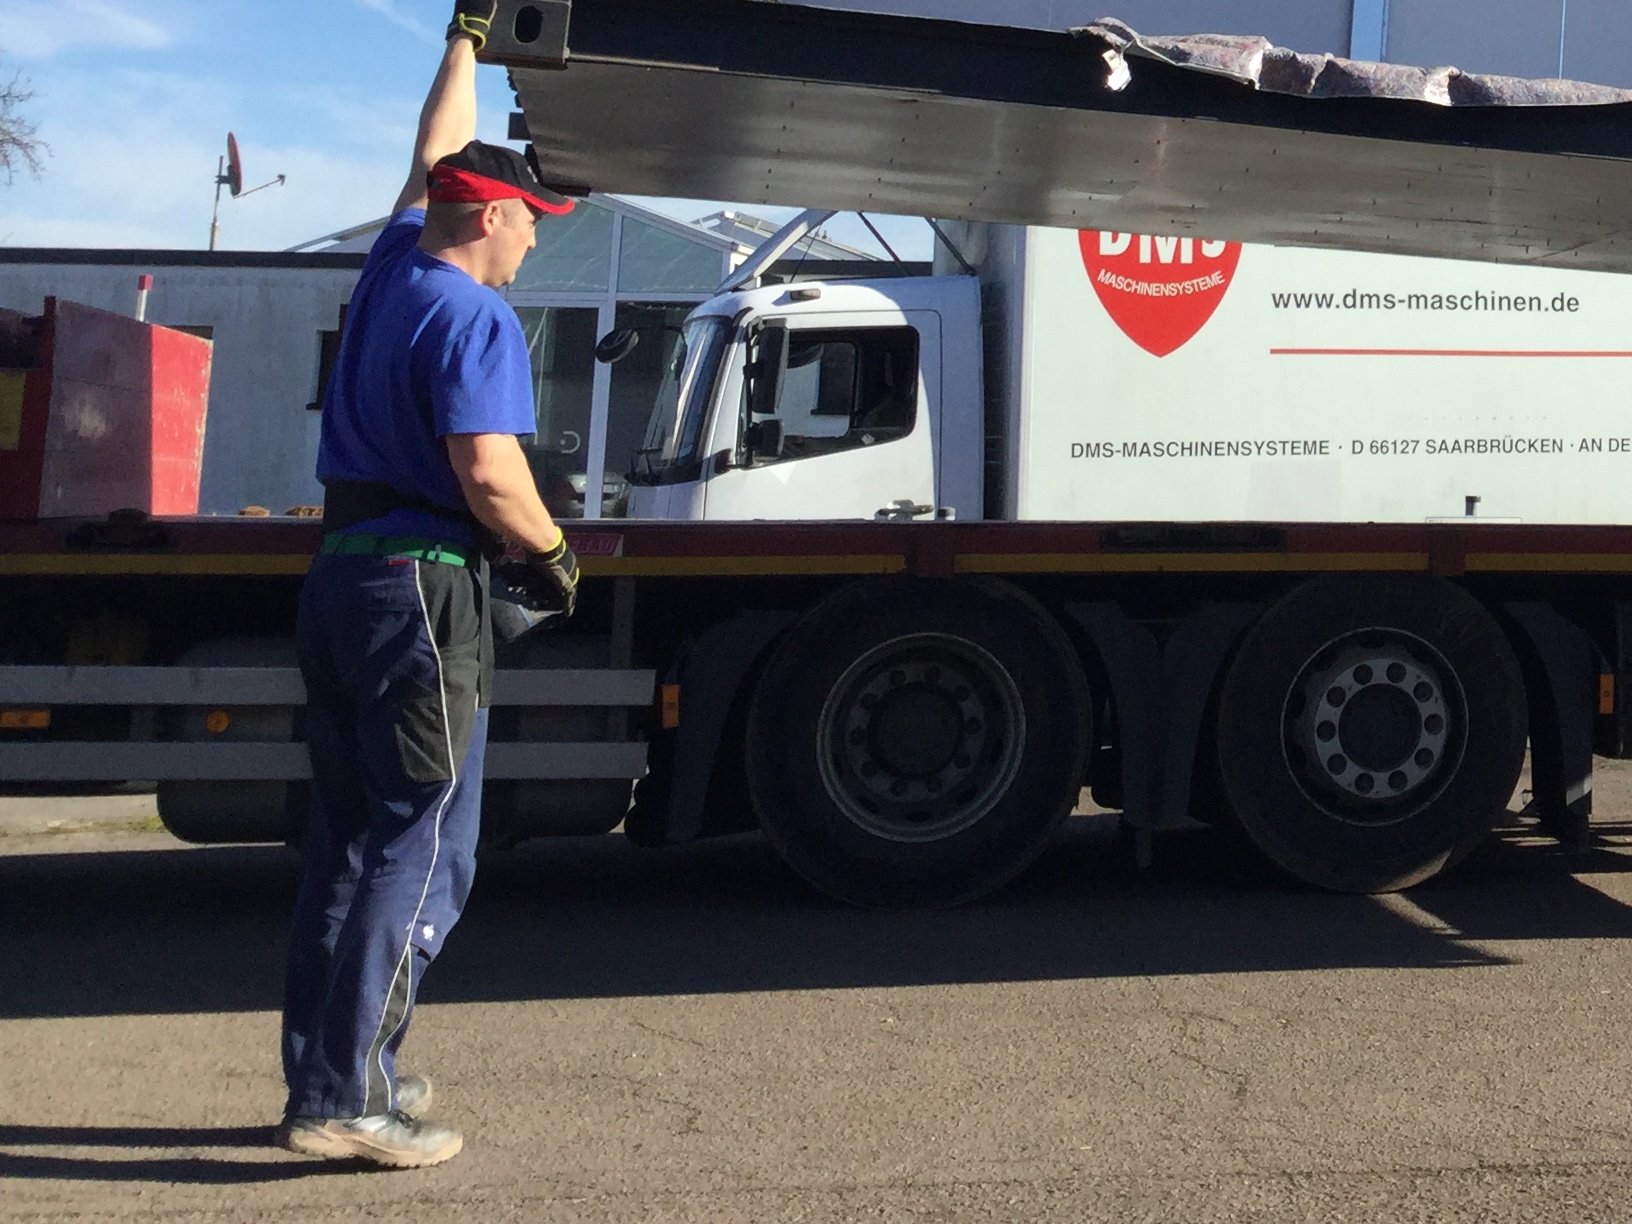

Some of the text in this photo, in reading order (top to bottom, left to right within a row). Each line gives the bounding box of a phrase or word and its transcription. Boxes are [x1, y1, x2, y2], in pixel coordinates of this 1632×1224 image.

[1097, 269, 1226, 297] MASCHINENSYSTEME
[1271, 288, 1580, 313] www.dms-maschinen.de
[1070, 440, 1330, 459] DMS-MASCHINENSYSTEME
[1351, 439, 1364, 455] D
[1369, 439, 1420, 455] 66127
[1425, 434, 1564, 455] SAARBRÜCKEN
[1578, 438, 1603, 453] AN
